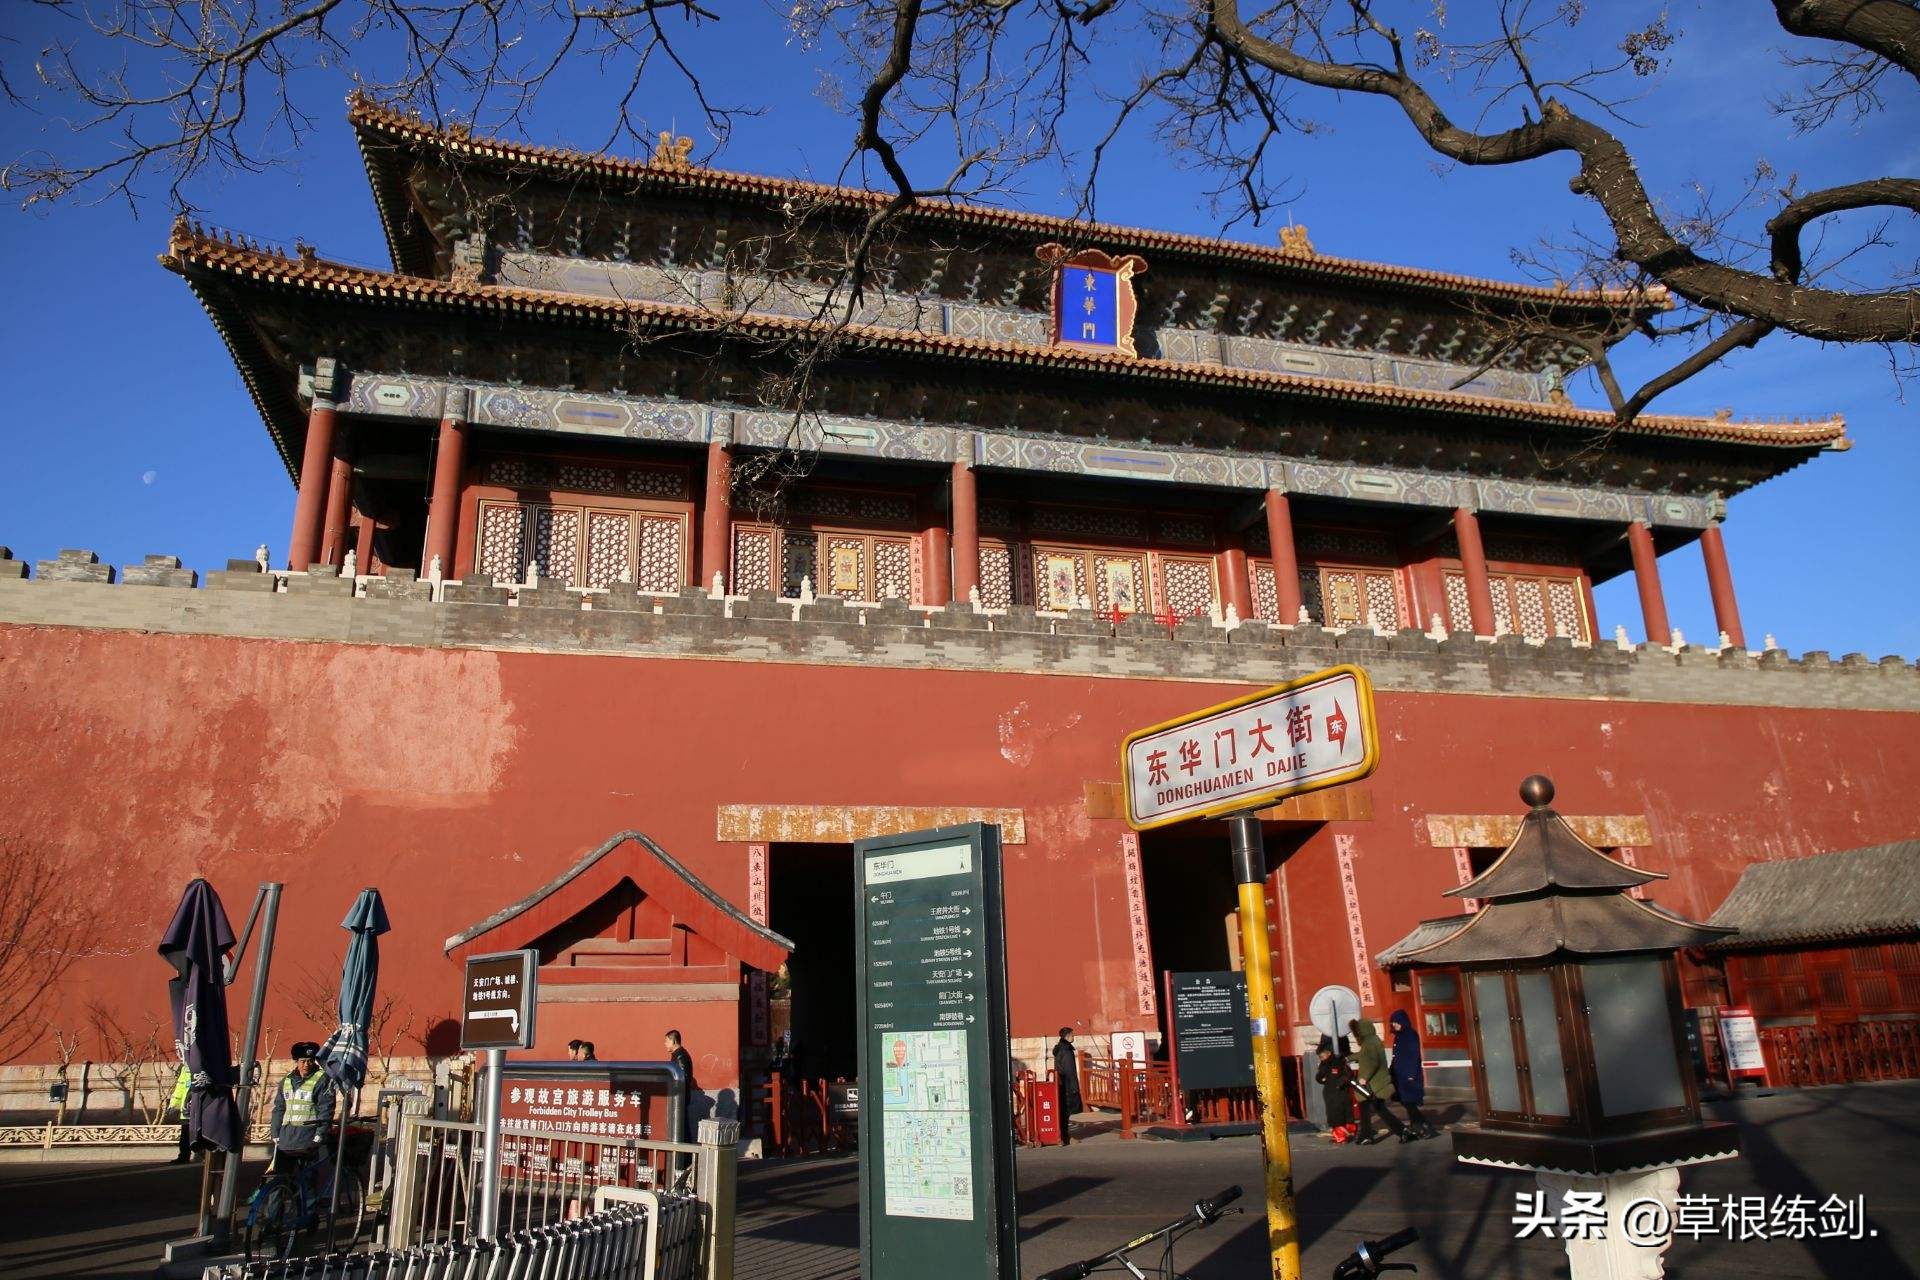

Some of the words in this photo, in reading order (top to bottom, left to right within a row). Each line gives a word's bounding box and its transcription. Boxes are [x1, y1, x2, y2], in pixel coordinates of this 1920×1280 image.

[1331, 719, 1344, 735] 东
[1146, 704, 1312, 787] 东华门大街
[1157, 768, 1254, 806] DONGHUAMEN
[1267, 752, 1308, 778] DAJIE
[932, 969, 962, 979] 天安门广场
[510, 1087, 642, 1108] 参观故宫旅游服务车
[529, 1106, 562, 1116] Forbidden
[563, 1107, 577, 1118] City
[578, 1108, 603, 1119] Trolley
[604, 1109, 618, 1118] Bus
[1043, 1101, 1051, 1122] 出口
